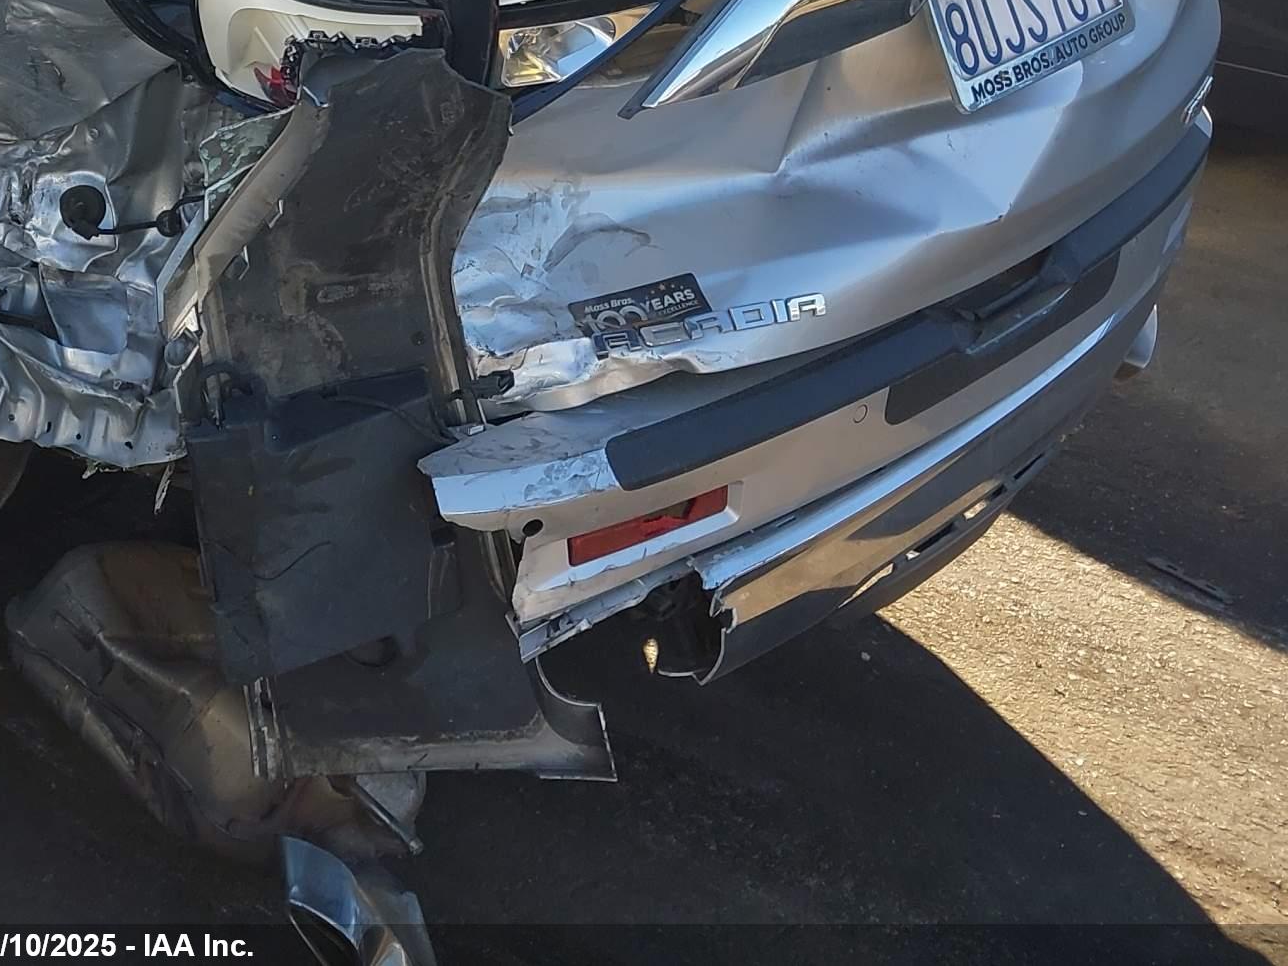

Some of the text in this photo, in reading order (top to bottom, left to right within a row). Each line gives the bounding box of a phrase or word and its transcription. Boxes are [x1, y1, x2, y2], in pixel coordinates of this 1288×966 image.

[970, 13, 1126, 103] MOSS BROS. AUTO GROUP
[584, 301, 610, 314] Moss
[640, 288, 695, 313] YEARS
[592, 292, 826, 360] ACADIA
